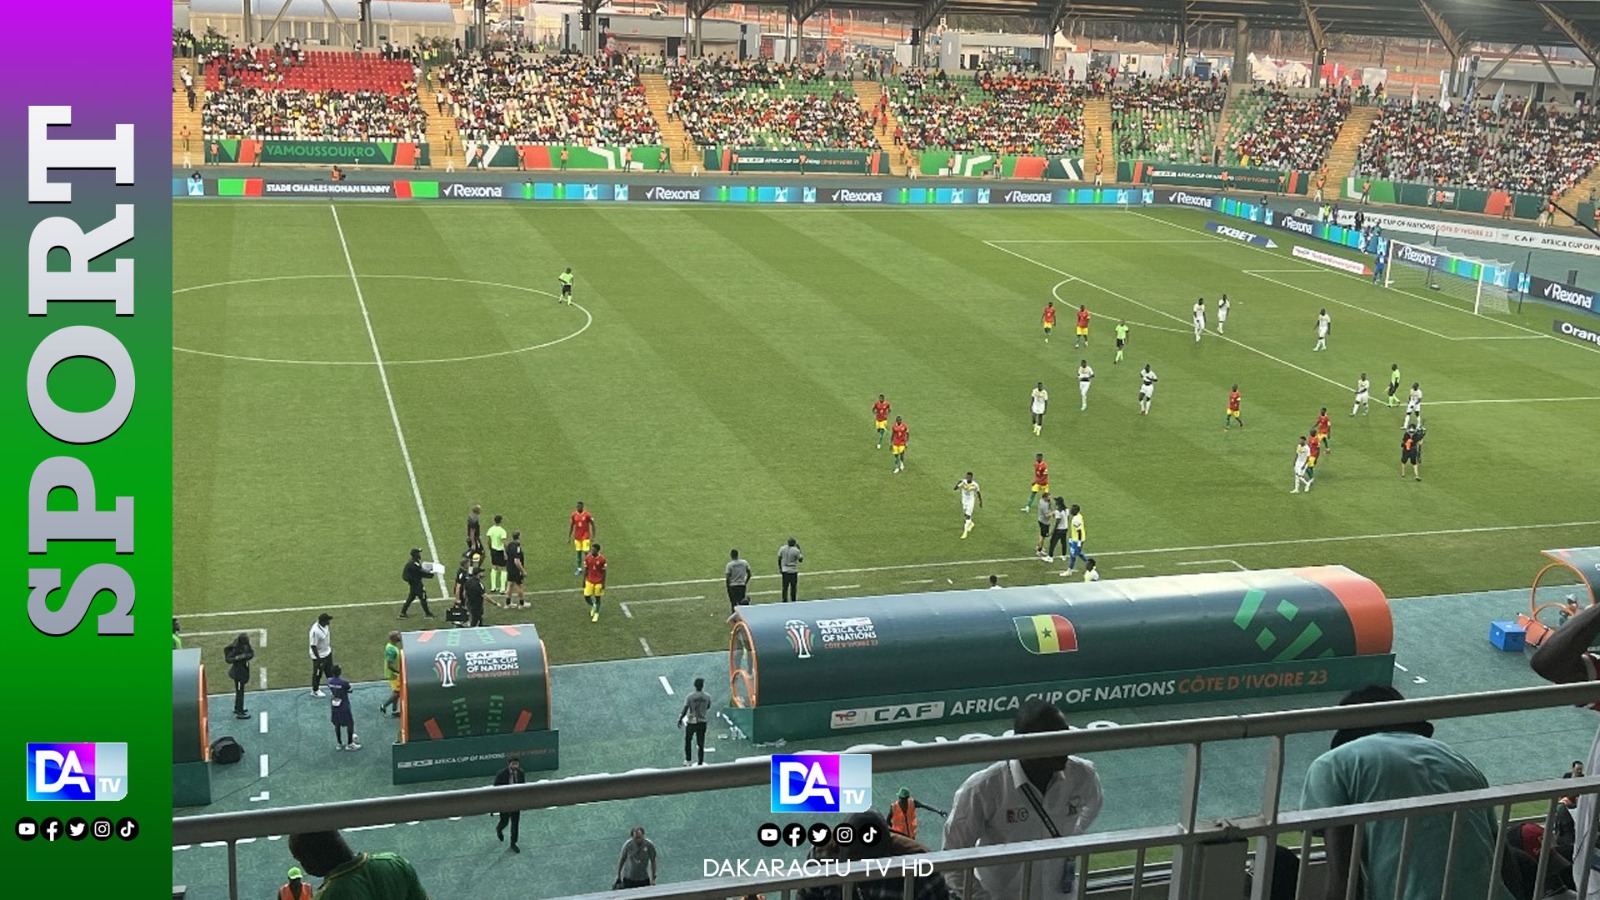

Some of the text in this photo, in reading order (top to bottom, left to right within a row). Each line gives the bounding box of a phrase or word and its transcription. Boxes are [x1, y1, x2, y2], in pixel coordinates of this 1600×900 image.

[265, 145, 375, 157] YAMOUSSOUKRO
[266, 184, 391, 194] STADE CHARLES KONAN BANNY
[453, 184, 502, 197] Rexona
[655, 186, 700, 200] Rexona
[840, 189, 882, 202] Rexona
[1012, 190, 1052, 203] Rexona
[1177, 191, 1213, 208] Rexona
[1287, 216, 1313, 235] Rexona
[1216, 225, 1257, 243] 1XBET
[1404, 246, 1438, 267] Rexona
[1551, 283, 1593, 309] Rexona
[821, 627, 854, 635] AFRICA
[822, 631, 877, 642] OF NATIONS
[467, 658, 499, 666] AFRICA
[480, 663, 519, 672] NATIONS
[950, 695, 1019, 715] AFRICA
[1066, 687, 1092, 704] OF
[1094, 680, 1176, 702] NATIONS
[1178, 675, 1223, 694] CÔTE
[1227, 671, 1304, 690] D'IVOIRE
[1308, 669, 1328, 686] 23
[874, 704, 934, 722] CAF
